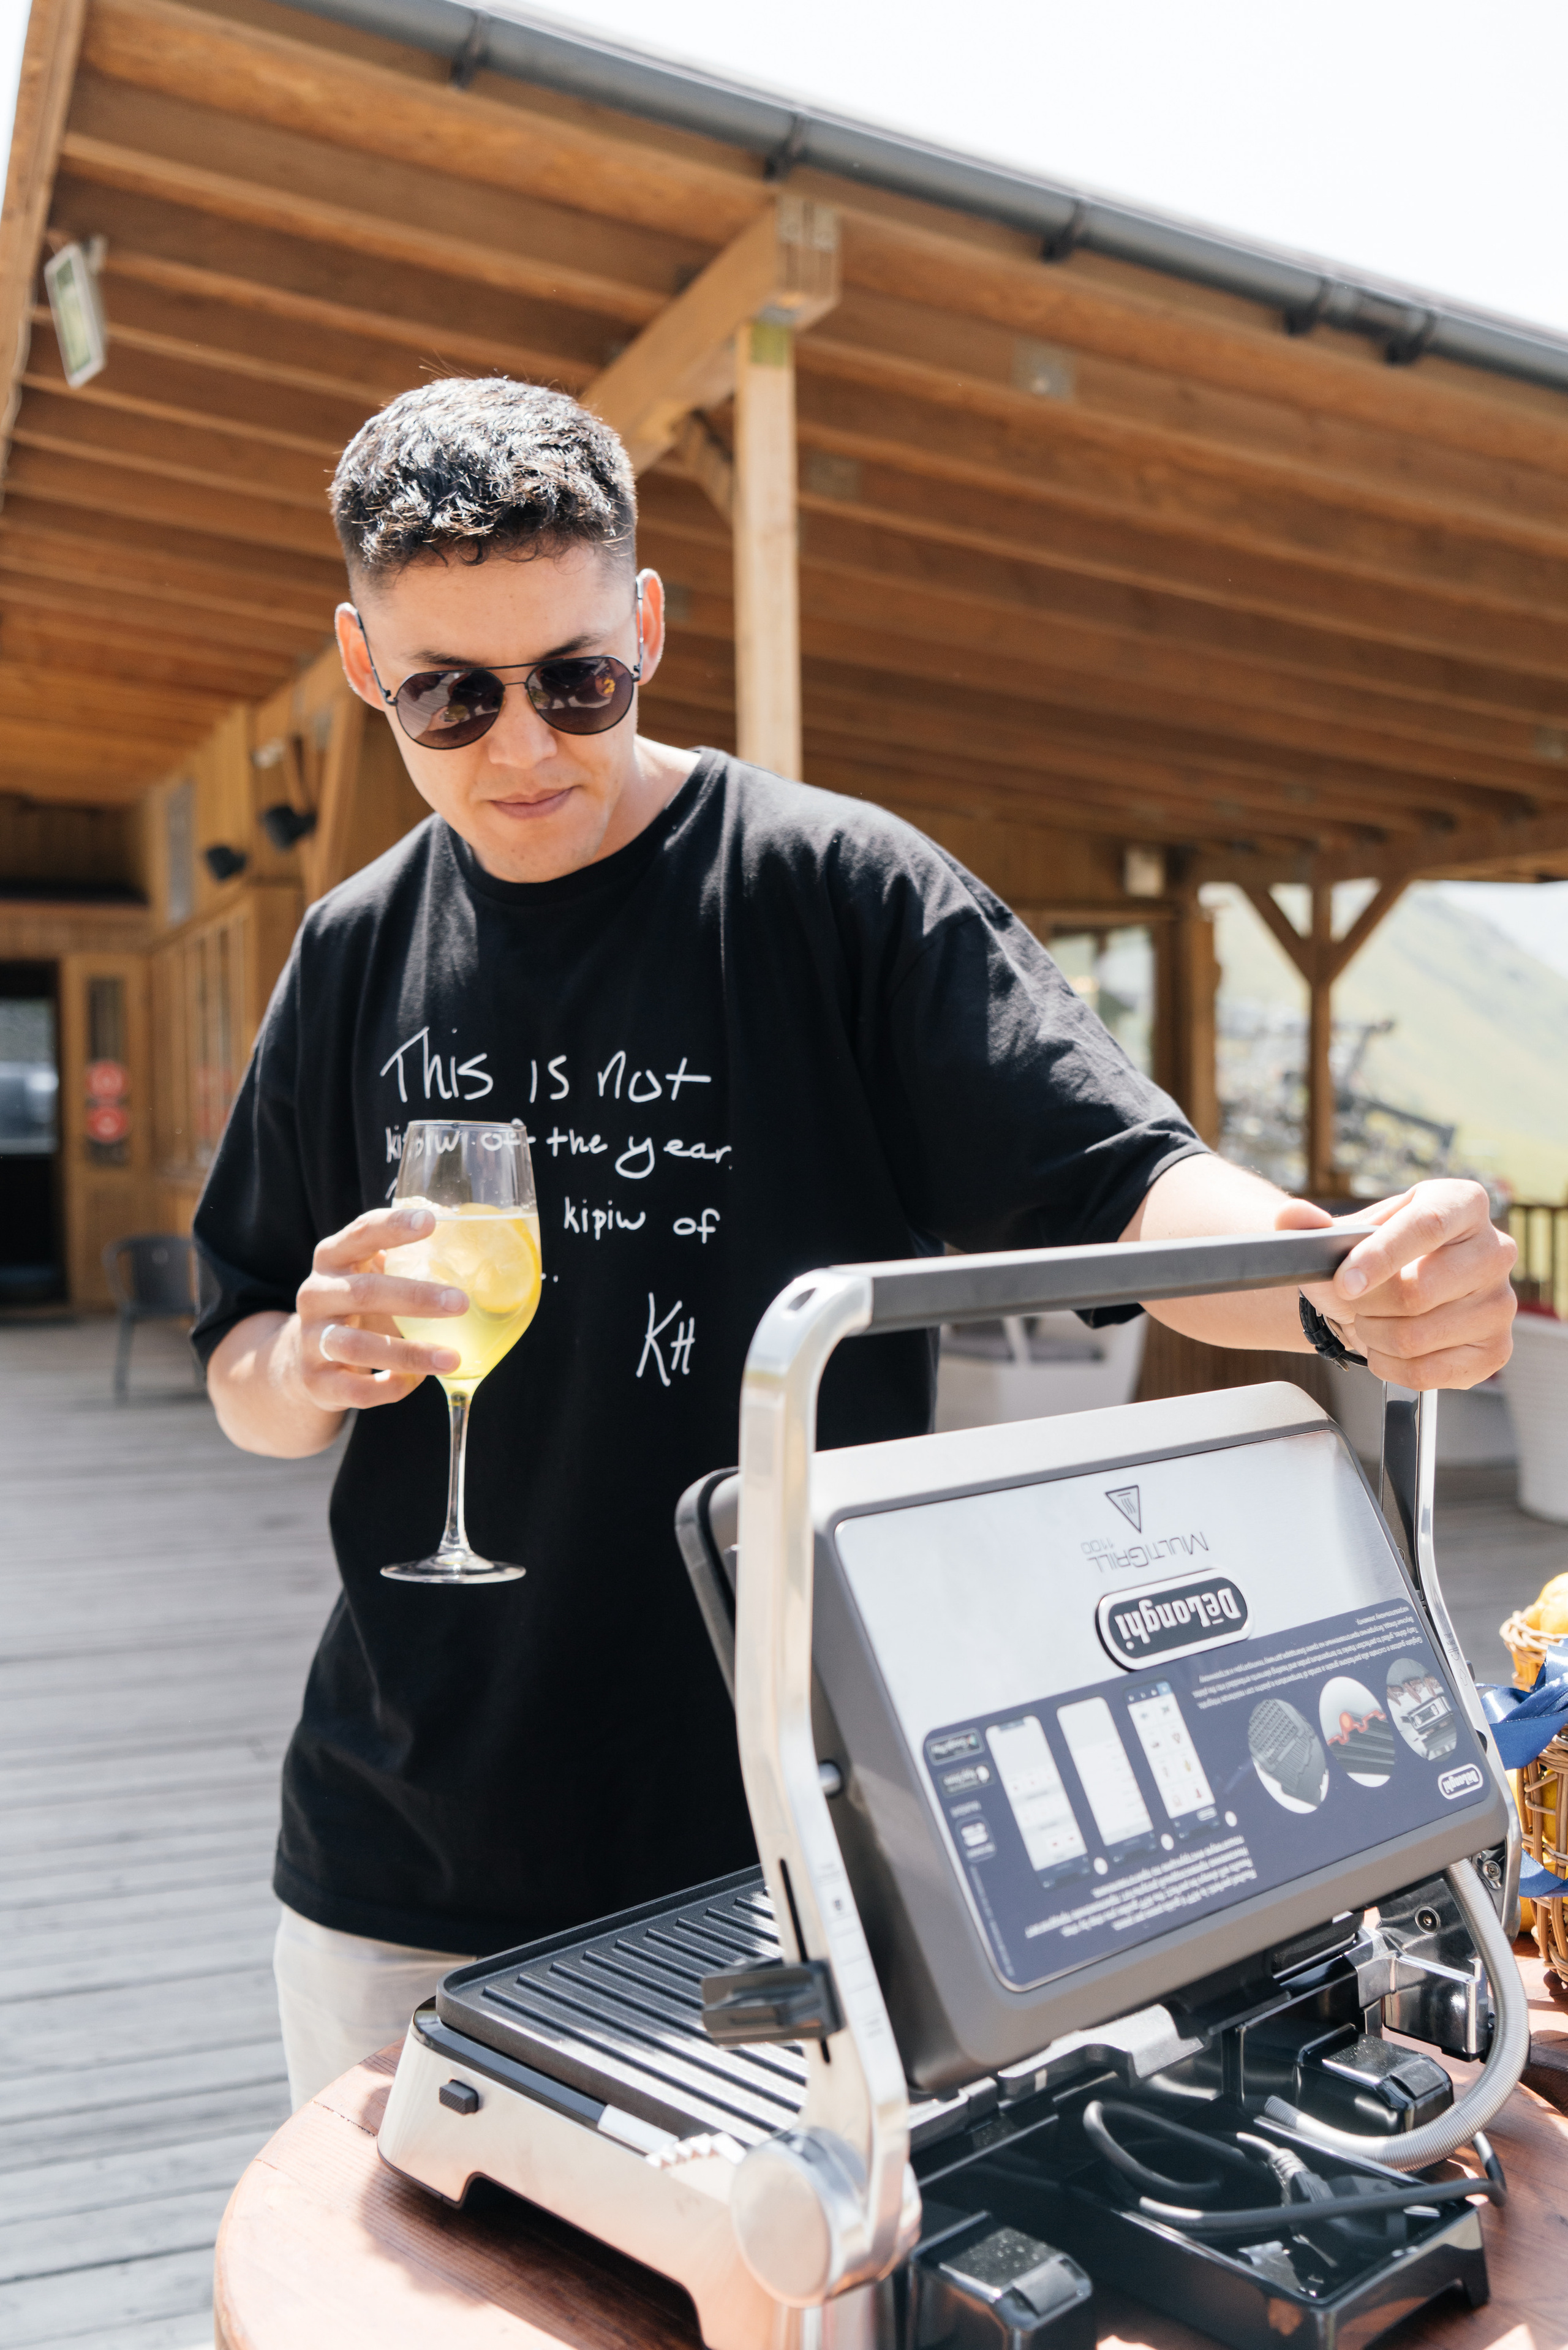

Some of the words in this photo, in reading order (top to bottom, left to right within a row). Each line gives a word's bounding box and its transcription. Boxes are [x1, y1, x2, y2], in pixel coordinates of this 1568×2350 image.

[381, 1026, 494, 1102] This
[546, 1126, 608, 1157] the
[564, 1196, 646, 1241] kipiw
[673, 1208, 720, 1244] of
